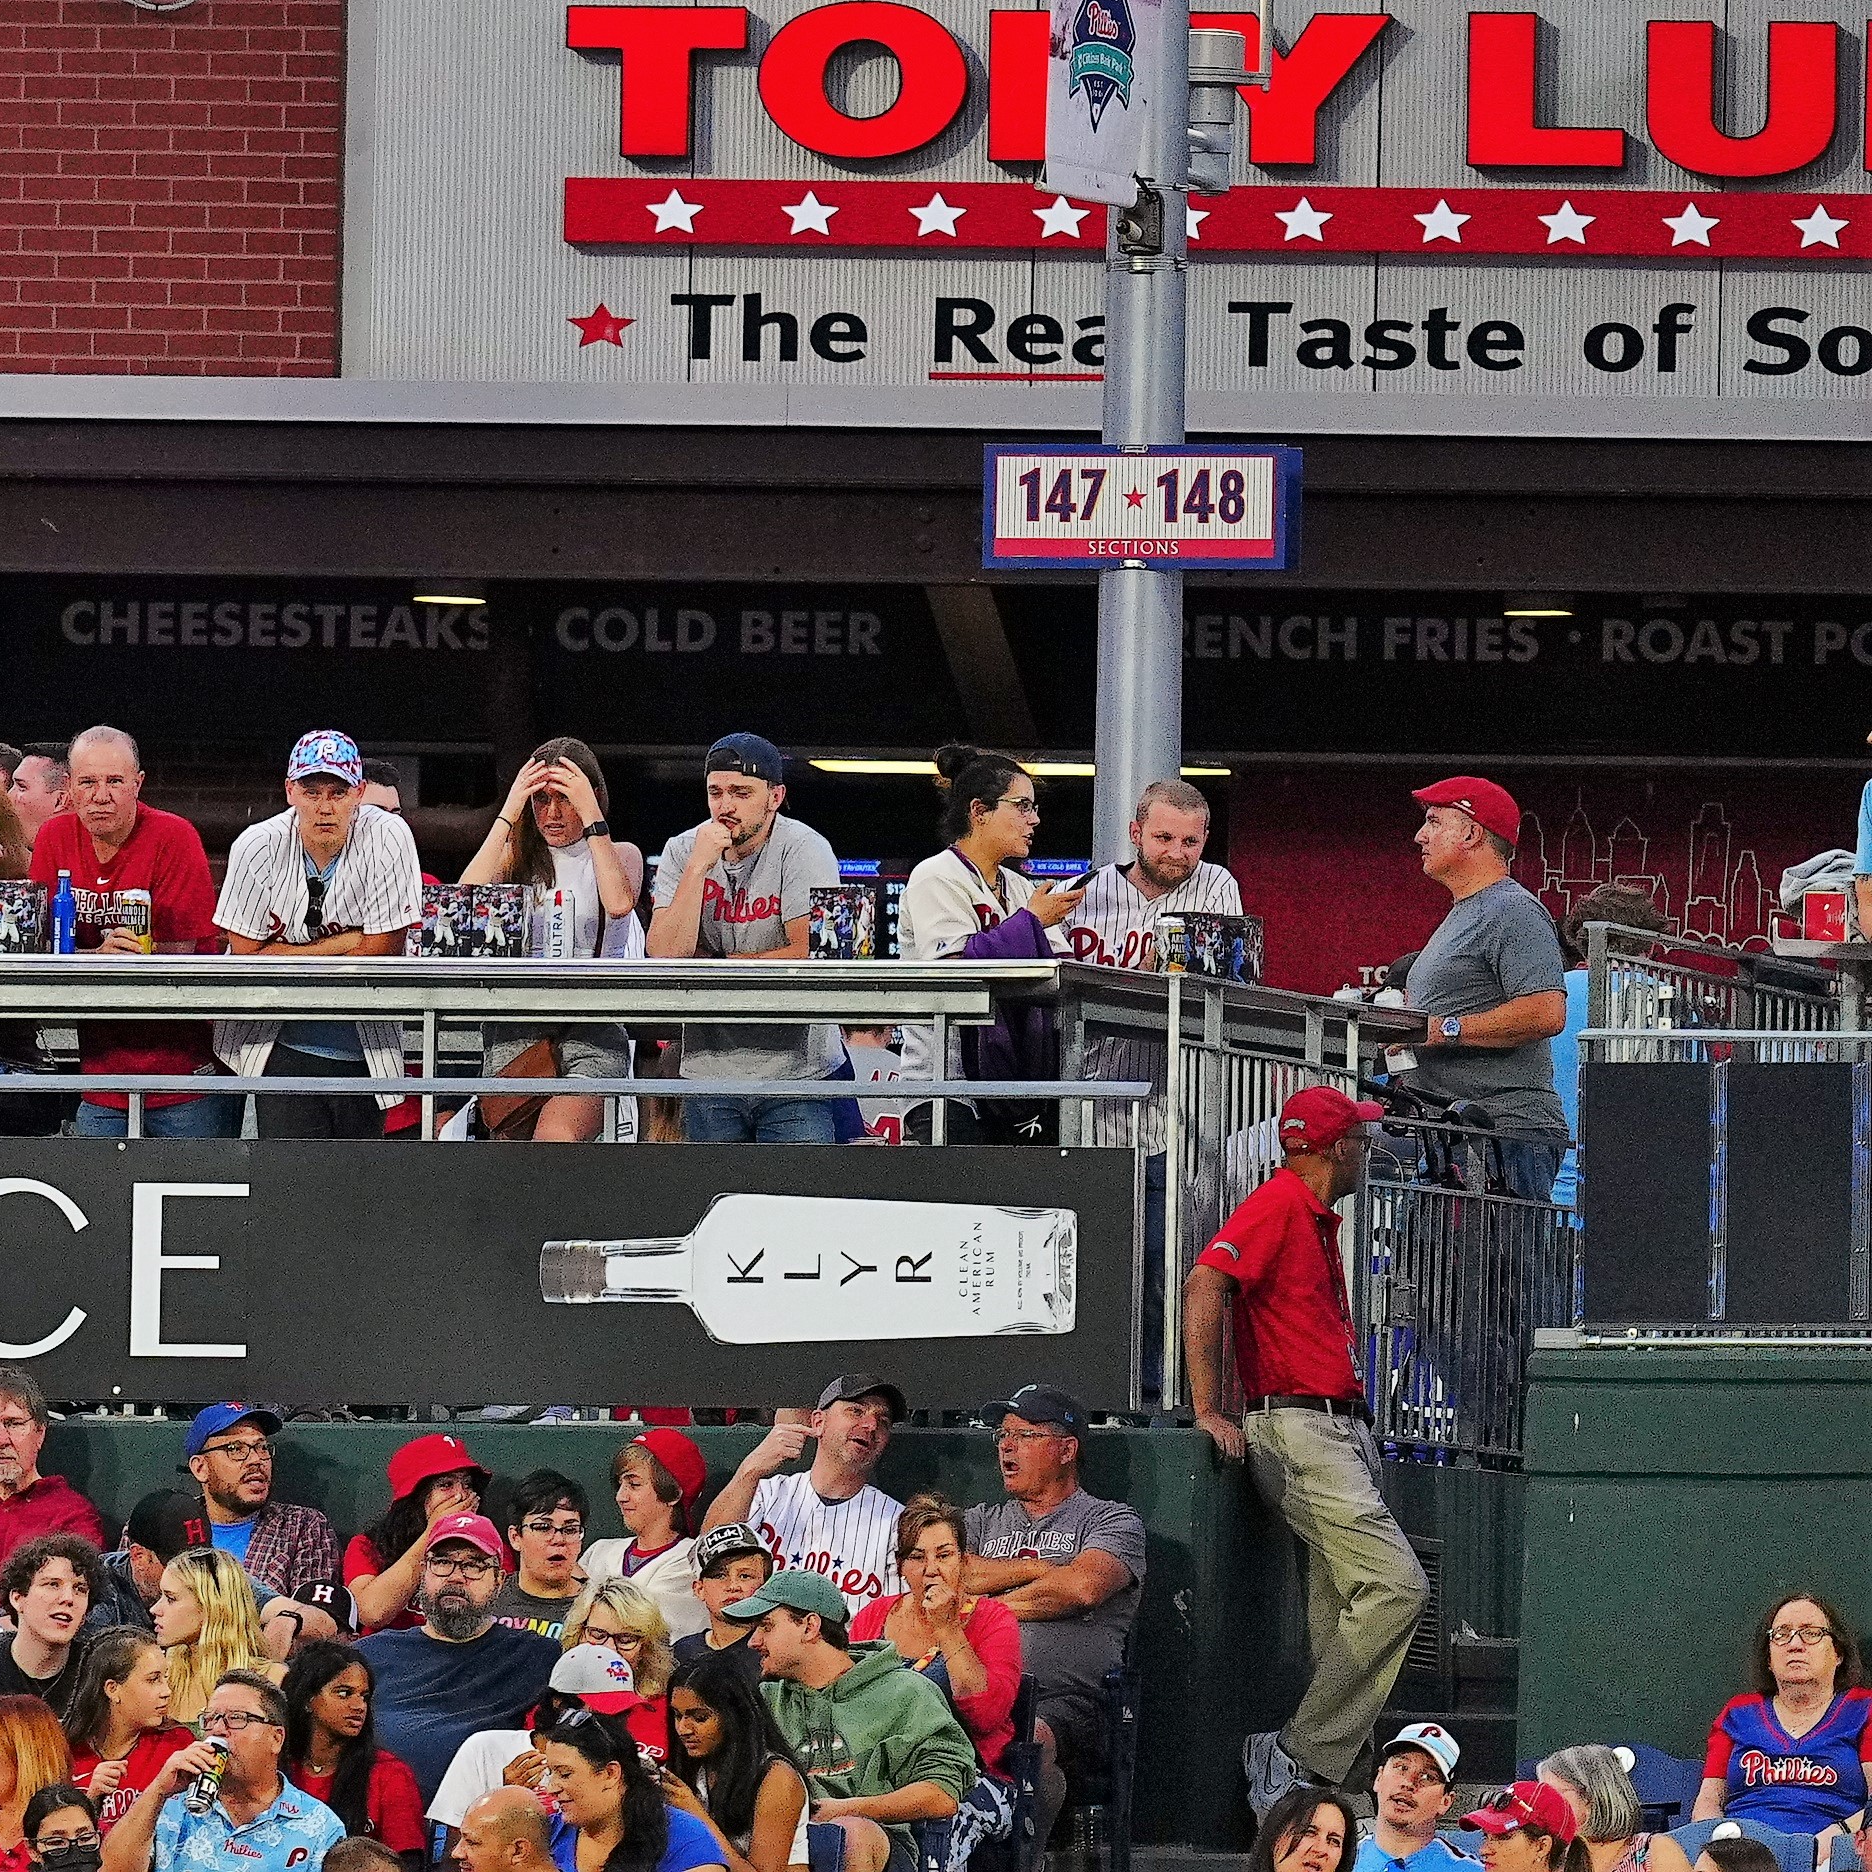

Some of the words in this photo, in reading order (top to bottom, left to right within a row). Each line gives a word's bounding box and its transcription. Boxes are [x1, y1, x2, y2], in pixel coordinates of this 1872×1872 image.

[1467, 8, 1872, 180] LU
[669, 290, 869, 364] The
[933, 296, 1106, 366] Rea
[1227, 300, 1526, 371] Taste
[1583, 302, 1696, 374] of
[1016, 466, 1105, 525] 147
[1155, 467, 1247, 526] 148
[1087, 538, 1181, 557] SECTIONS
[60, 599, 492, 652] CHEESESTEAKS
[555, 607, 717, 654] COLD
[739, 610, 884, 656] BEER
[1383, 617, 1539, 663] FRIES
[1600, 619, 1795, 665] ROAST
[552, 911, 564, 958] ULTRA
[959, 1240, 969, 1299] CLEAN
[972, 1221, 982, 1316] AMERICAN
[985, 1251, 995, 1288] RUM
[311, 1582, 334, 1603] H
[1416, 1724, 1443, 1739] P
[1740, 1749, 1838, 1787] Phillies
[222, 1837, 264, 1861] Phillies
[285, 1846, 309, 1869] P
